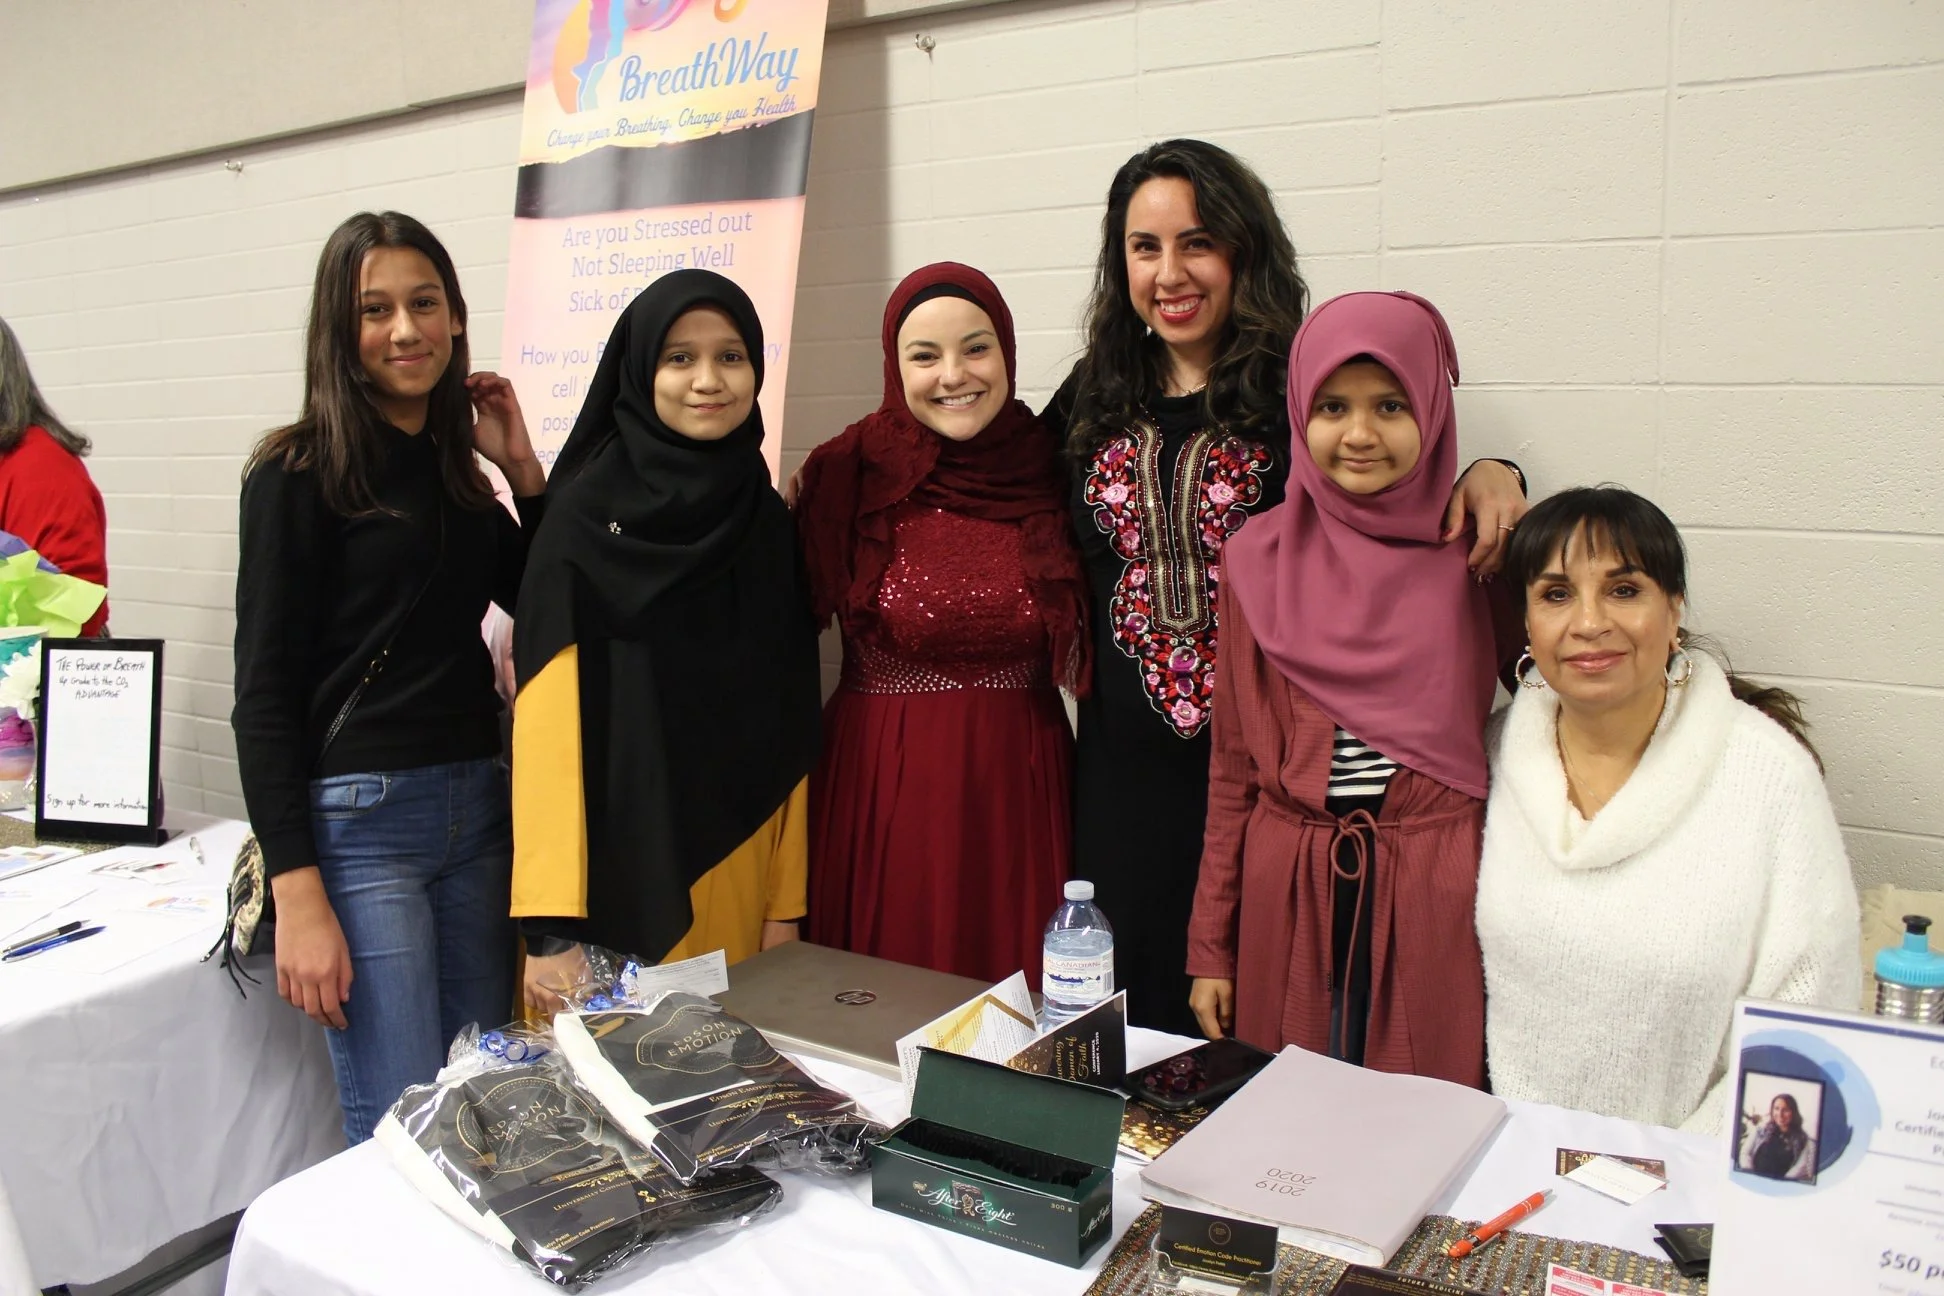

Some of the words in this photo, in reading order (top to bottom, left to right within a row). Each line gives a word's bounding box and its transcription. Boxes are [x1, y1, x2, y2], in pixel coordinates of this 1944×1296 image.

[547, 129, 585, 149] Change
[678, 108, 722, 129] Change
[723, 107, 749, 126] you
[752, 94, 797, 117] Health
[563, 226, 591, 249] Are
[596, 226, 628, 250] you
[634, 212, 713, 241] Stressed
[718, 213, 753, 234] out
[572, 256, 603, 278] Not
[608, 249, 686, 278] Sleeping
[691, 243, 735, 268] Well
[569, 290, 604, 313] Sick
[608, 287, 629, 310] of
[520, 345, 557, 365] How
[562, 349, 589, 370] you
[552, 375, 578, 398] cell
[66, 799, 76, 810] up
[78, 793, 91, 806] for
[667, 1027, 743, 1057] EMOTION
[674, 1021, 726, 1047] EDSON
[1255, 1180, 1306, 1197] 2019
[1267, 1168, 1317, 1185] 2020
[917, 1187, 964, 1210] After
[1879, 1248, 1921, 1273] $50
